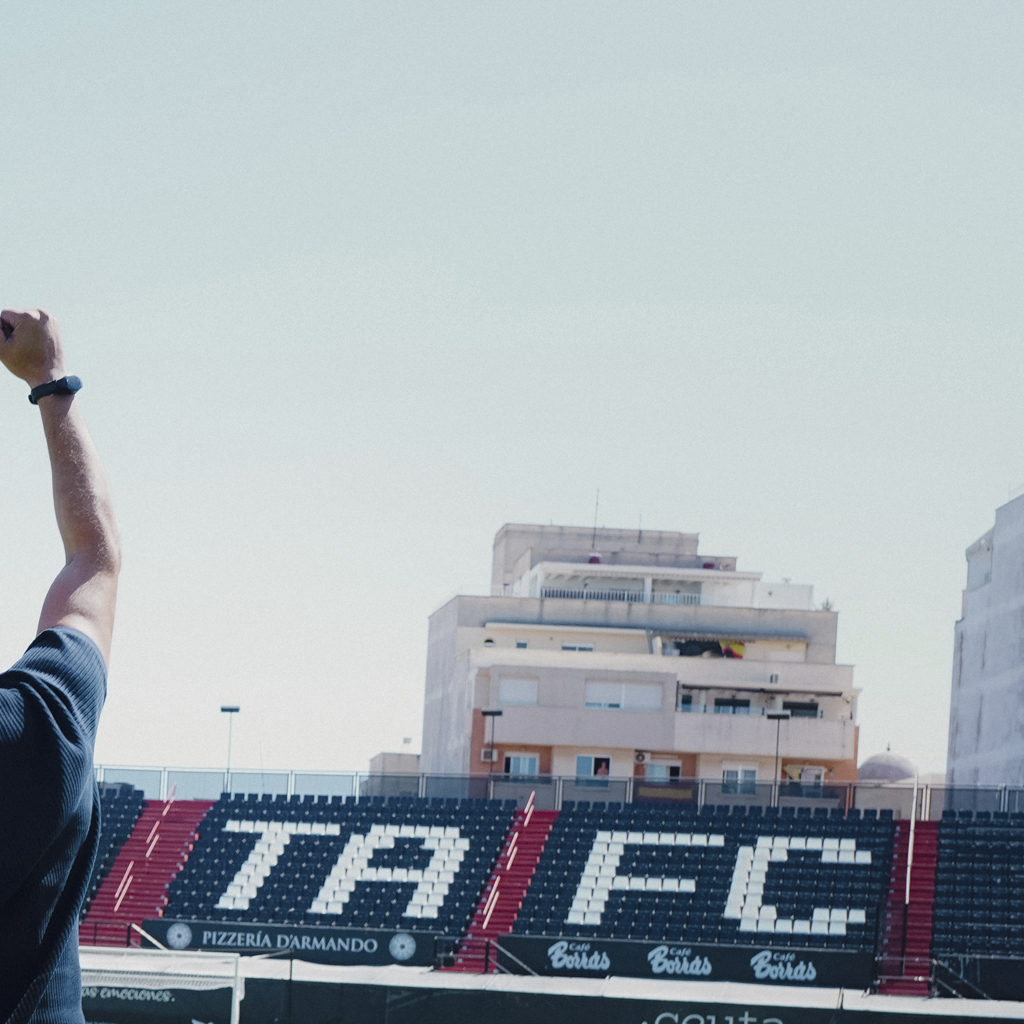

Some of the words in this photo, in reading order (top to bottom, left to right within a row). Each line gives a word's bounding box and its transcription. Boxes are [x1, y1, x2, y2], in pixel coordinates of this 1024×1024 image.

[563, 830, 872, 936] FC
[202, 930, 272, 948] PIZZERÍA
[277, 934, 378, 953] D'ARMANDO
[568, 942, 591, 952] Café
[669, 946, 692, 957] Café
[773, 952, 796, 963] Café
